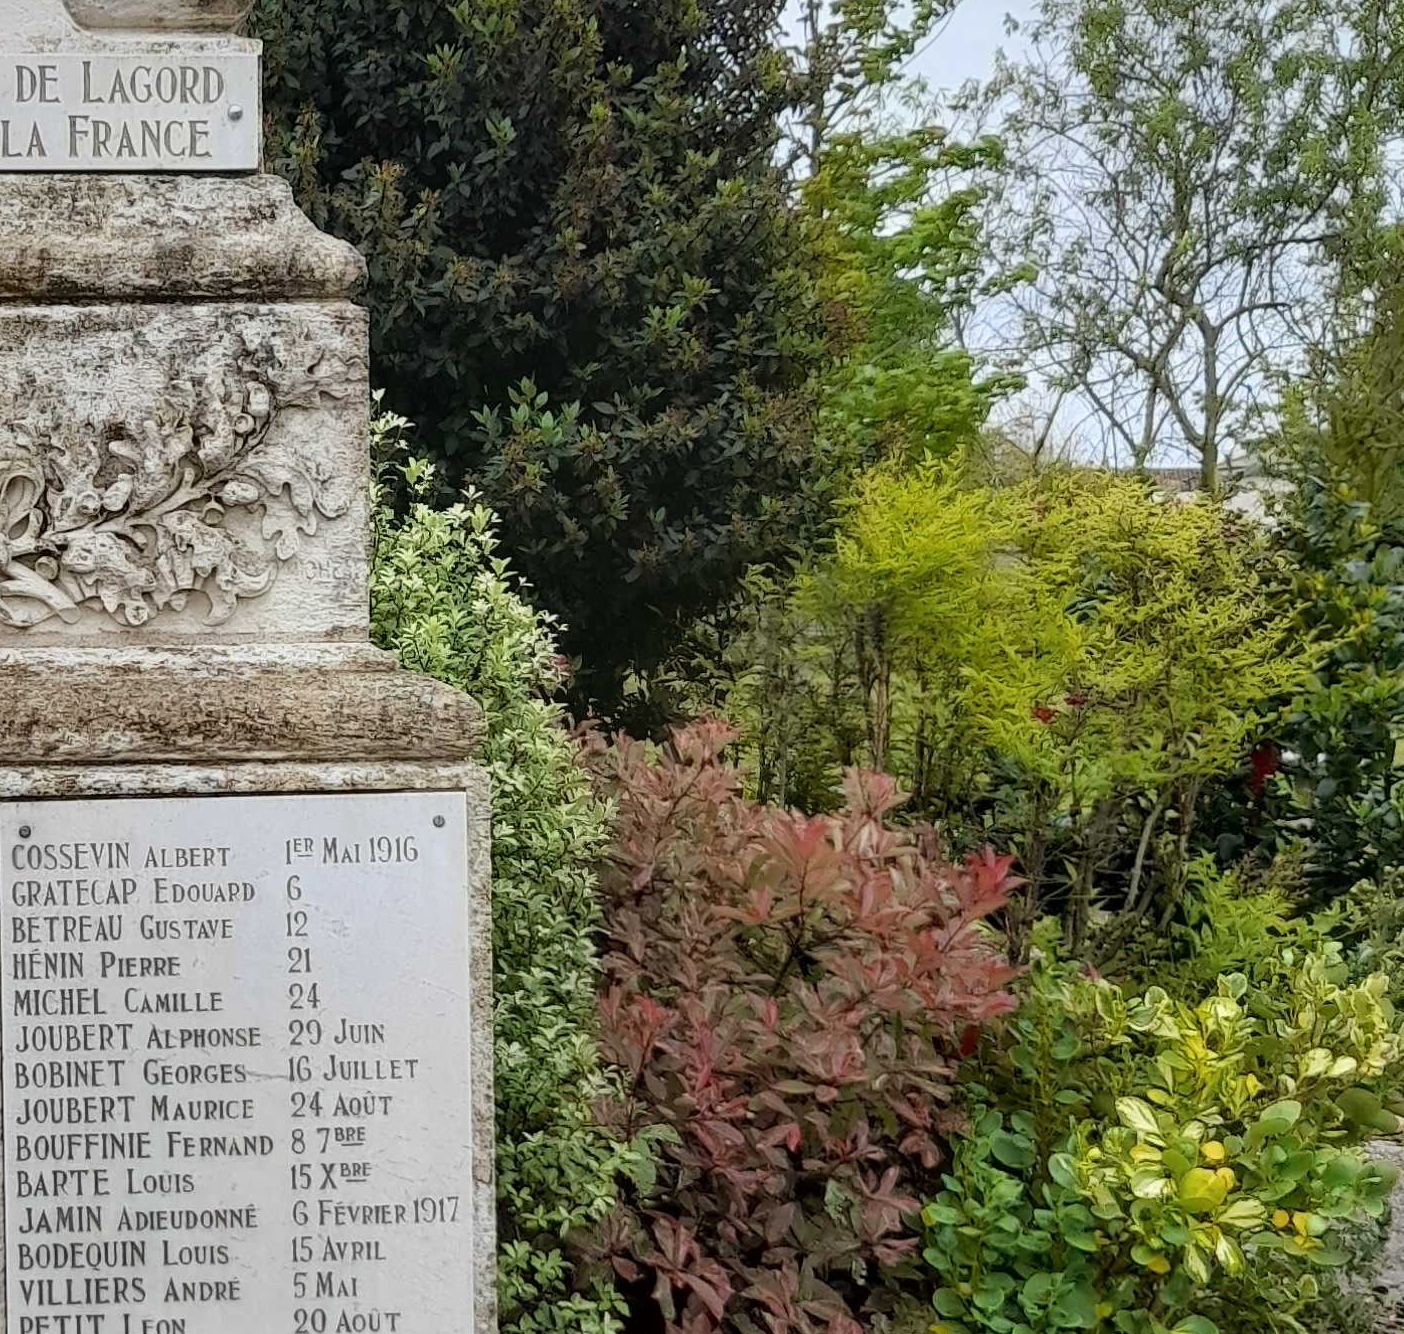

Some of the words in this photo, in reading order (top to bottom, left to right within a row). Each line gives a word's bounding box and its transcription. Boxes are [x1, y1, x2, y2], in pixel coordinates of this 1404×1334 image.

[15, 65, 60, 103] DE
[82, 61, 224, 104] LAGORD
[1, 120, 47, 157] LA
[68, 115, 212, 158] FRANCE
[12, 842, 129, 870] COSSEVIN
[144, 846, 230, 868] ALBERT
[323, 837, 360, 864] MAI
[369, 836, 418, 862] 1916
[12, 878, 137, 907] GRATECAP
[154, 878, 255, 904] EDOUARD
[140, 914, 233, 940] GUSTAVE
[287, 911, 308, 936] 12
[13, 949, 83, 980] HÉNIN
[100, 951, 180, 978] PIERRE
[288, 947, 311, 973] 21
[14, 988, 107, 1016] MICHEL
[124, 988, 224, 1013] CAMILLE
[289, 983, 320, 1010] 24
[16, 1024, 133, 1052] JOUBERT
[147, 1024, 261, 1049] ALPHONSE
[334, 1018, 384, 1044] JUIN
[15, 1060, 125, 1089] BOBINET
[143, 1058, 246, 1085] GEORGES
[289, 1055, 312, 1083] 16
[323, 1055, 418, 1081] JUILLET
[16, 1096, 135, 1125] JOUBERT
[151, 1095, 253, 1121] MAURICE
[291, 1091, 323, 1117] 24
[333, 1091, 392, 1118] AOÛT
[16, 1132, 151, 1161] BOUFFINIE
[167, 1131, 273, 1158] FERNAND
[17, 1169, 110, 1198] BARTE
[127, 1168, 194, 1194] LOUIS
[291, 1164, 311, 1190] 15
[19, 1206, 101, 1234] JAMIN
[117, 1204, 258, 1231] ADIEUDONNÉ
[18, 1241, 145, 1271] BODEQUIN
[163, 1240, 229, 1266] LOUIS
[292, 1236, 313, 1263] 15
[322, 1236, 386, 1262] AVRIL
[19, 1277, 146, 1306] VILLIERS
[164, 1277, 240, 1302] ANDRÉ
[316, 1271, 357, 1298] MAI
